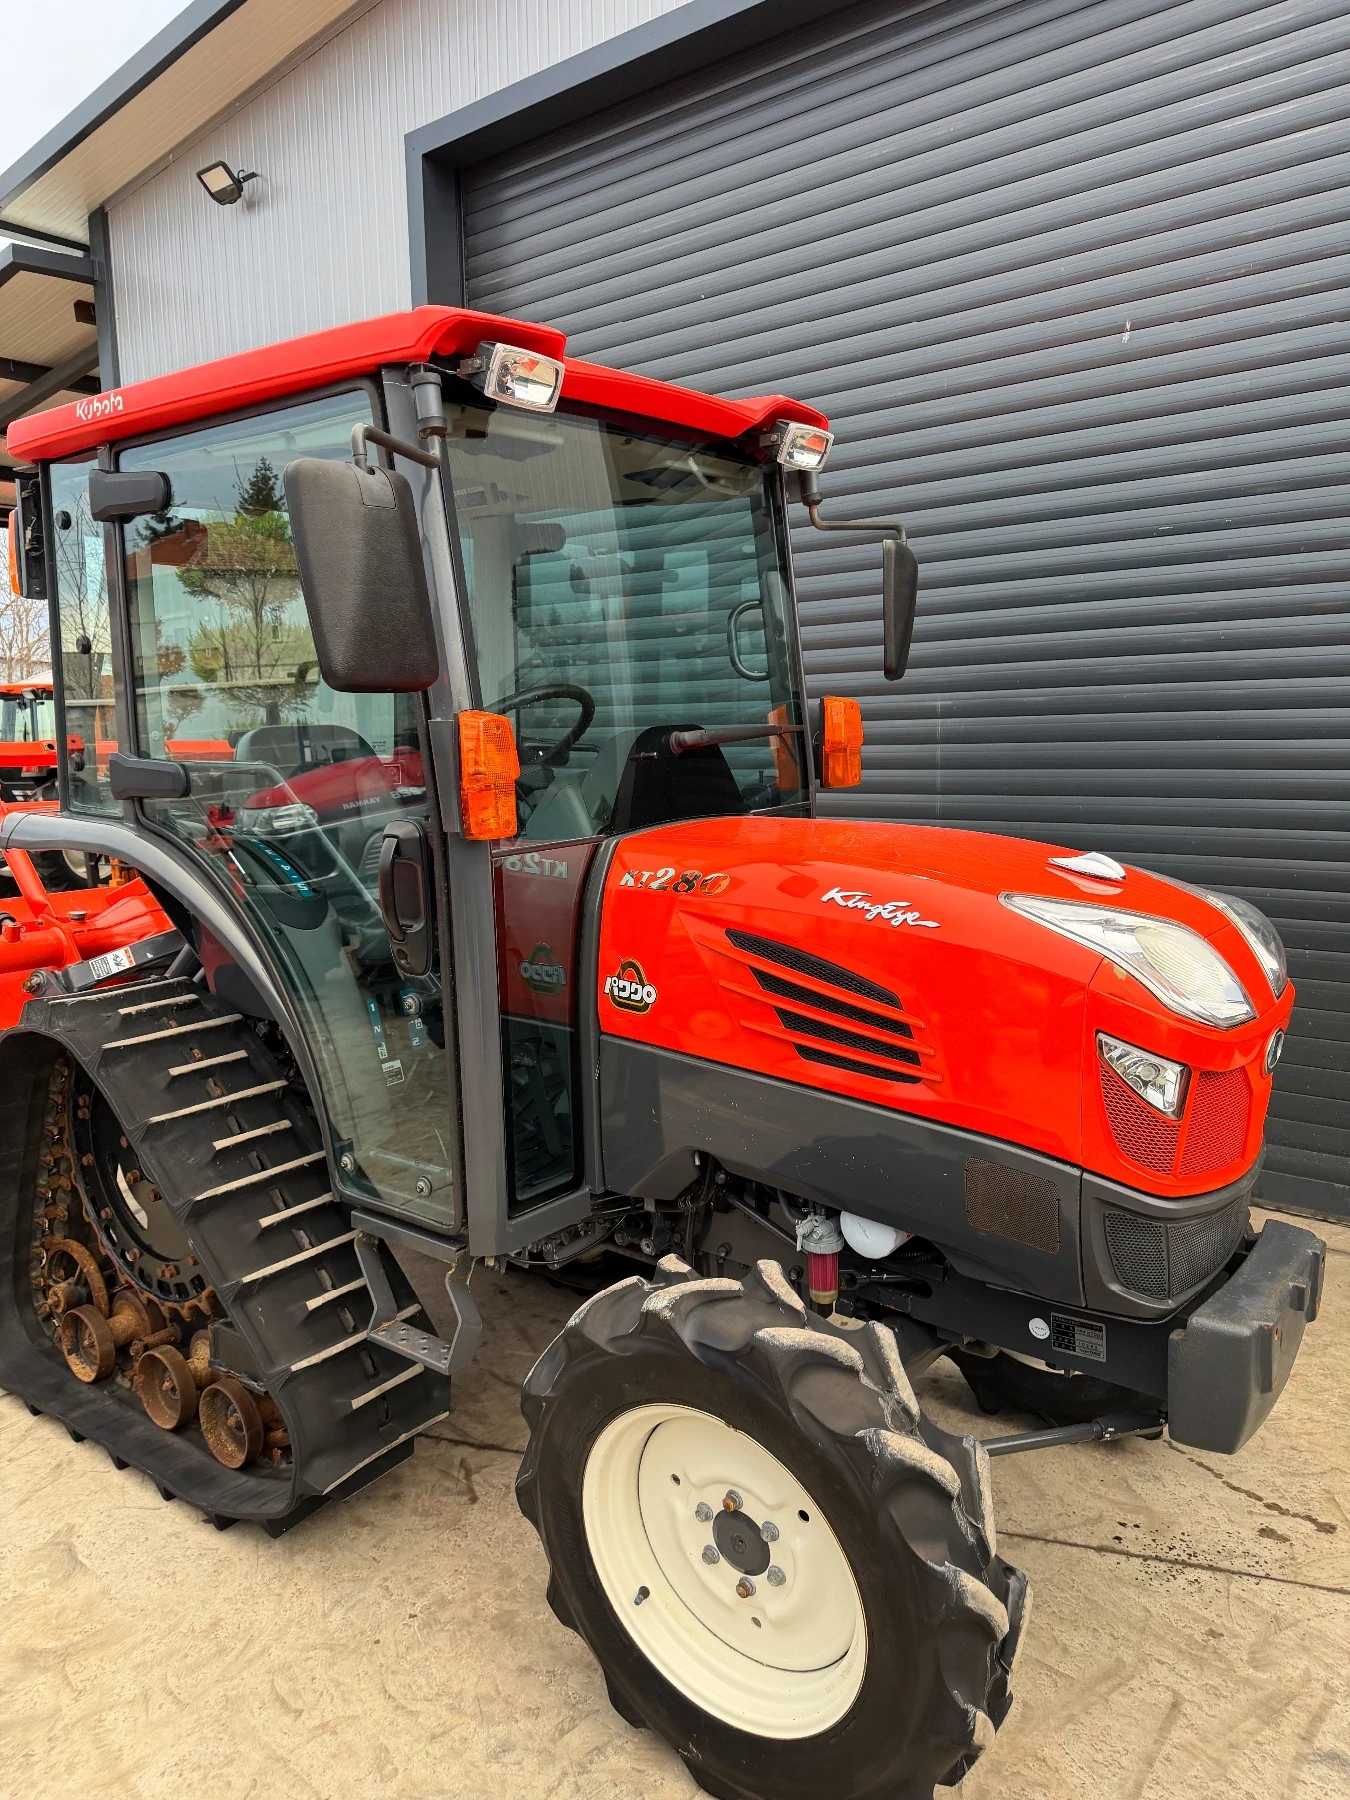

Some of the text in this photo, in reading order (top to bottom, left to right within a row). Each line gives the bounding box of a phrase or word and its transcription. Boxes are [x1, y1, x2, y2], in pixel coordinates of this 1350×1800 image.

[76, 393, 124, 420] Kubota
[619, 867, 731, 896] KT280
[820, 886, 941, 928] KingEye
